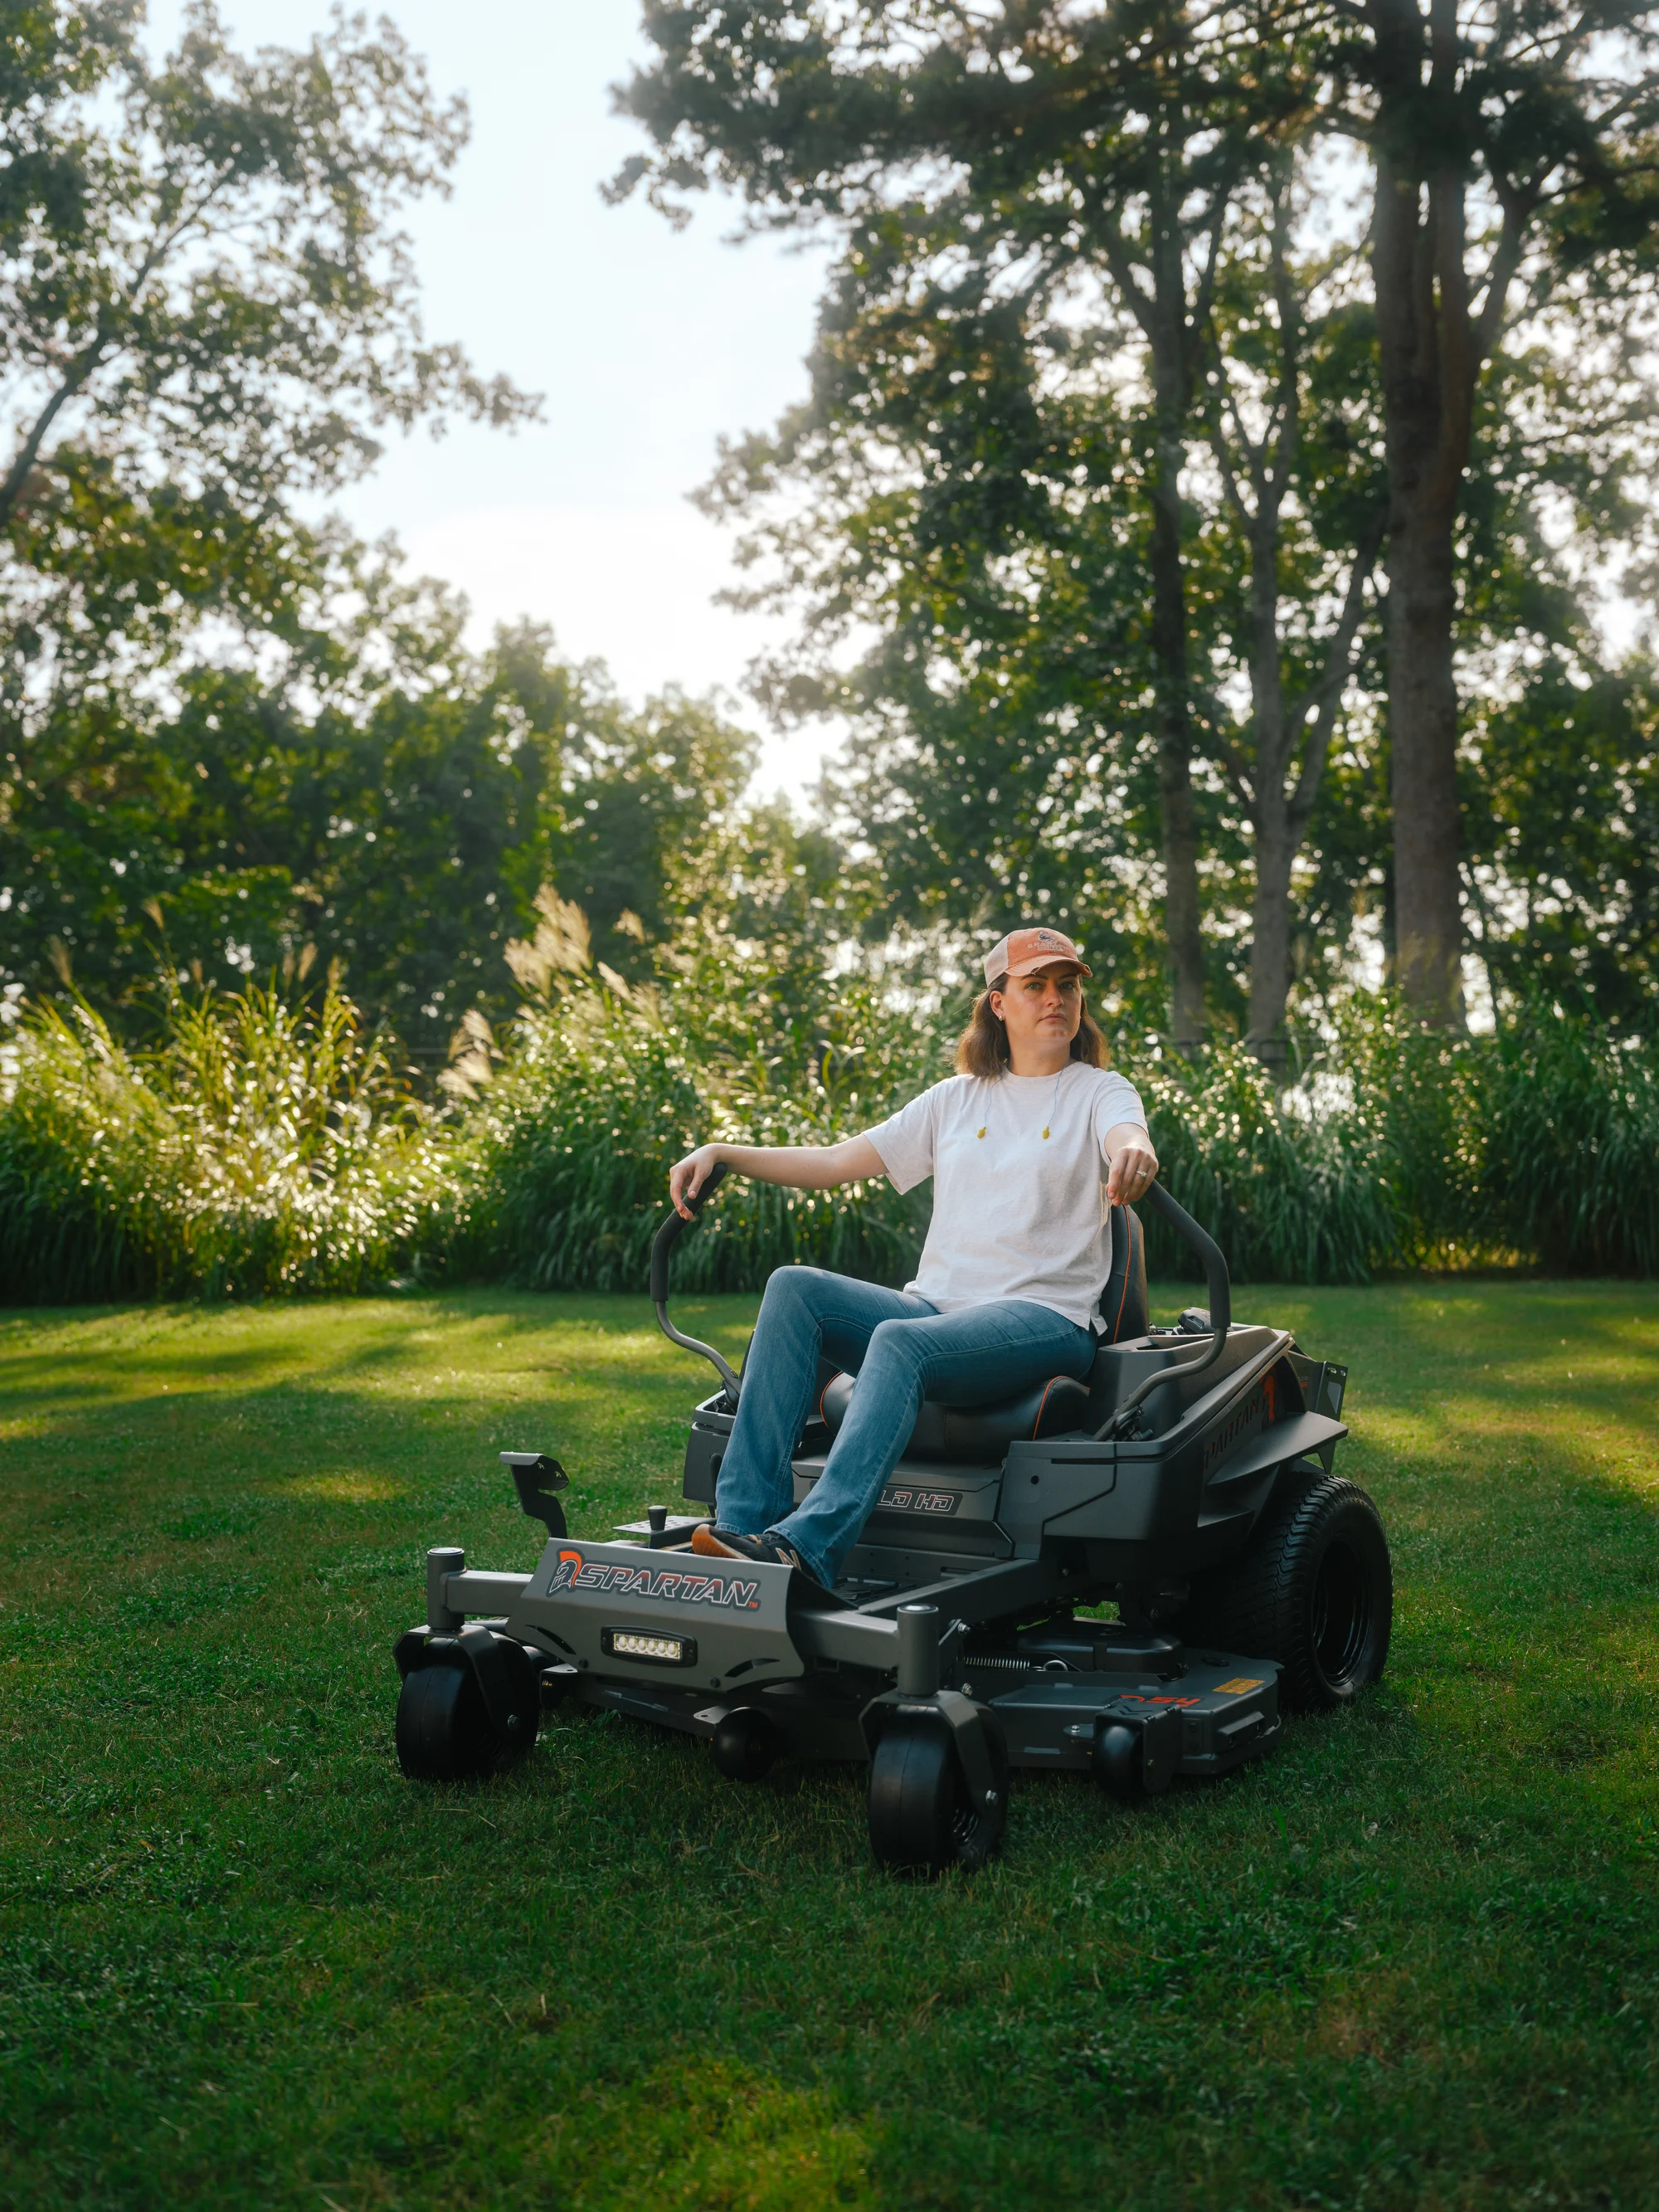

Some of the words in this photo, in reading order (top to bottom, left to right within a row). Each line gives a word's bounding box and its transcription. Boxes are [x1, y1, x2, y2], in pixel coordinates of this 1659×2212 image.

[1204, 1394, 1260, 1469] PARTAN
[914, 1493, 955, 1512] HD
[574, 1563, 757, 1607] SPARTAN
